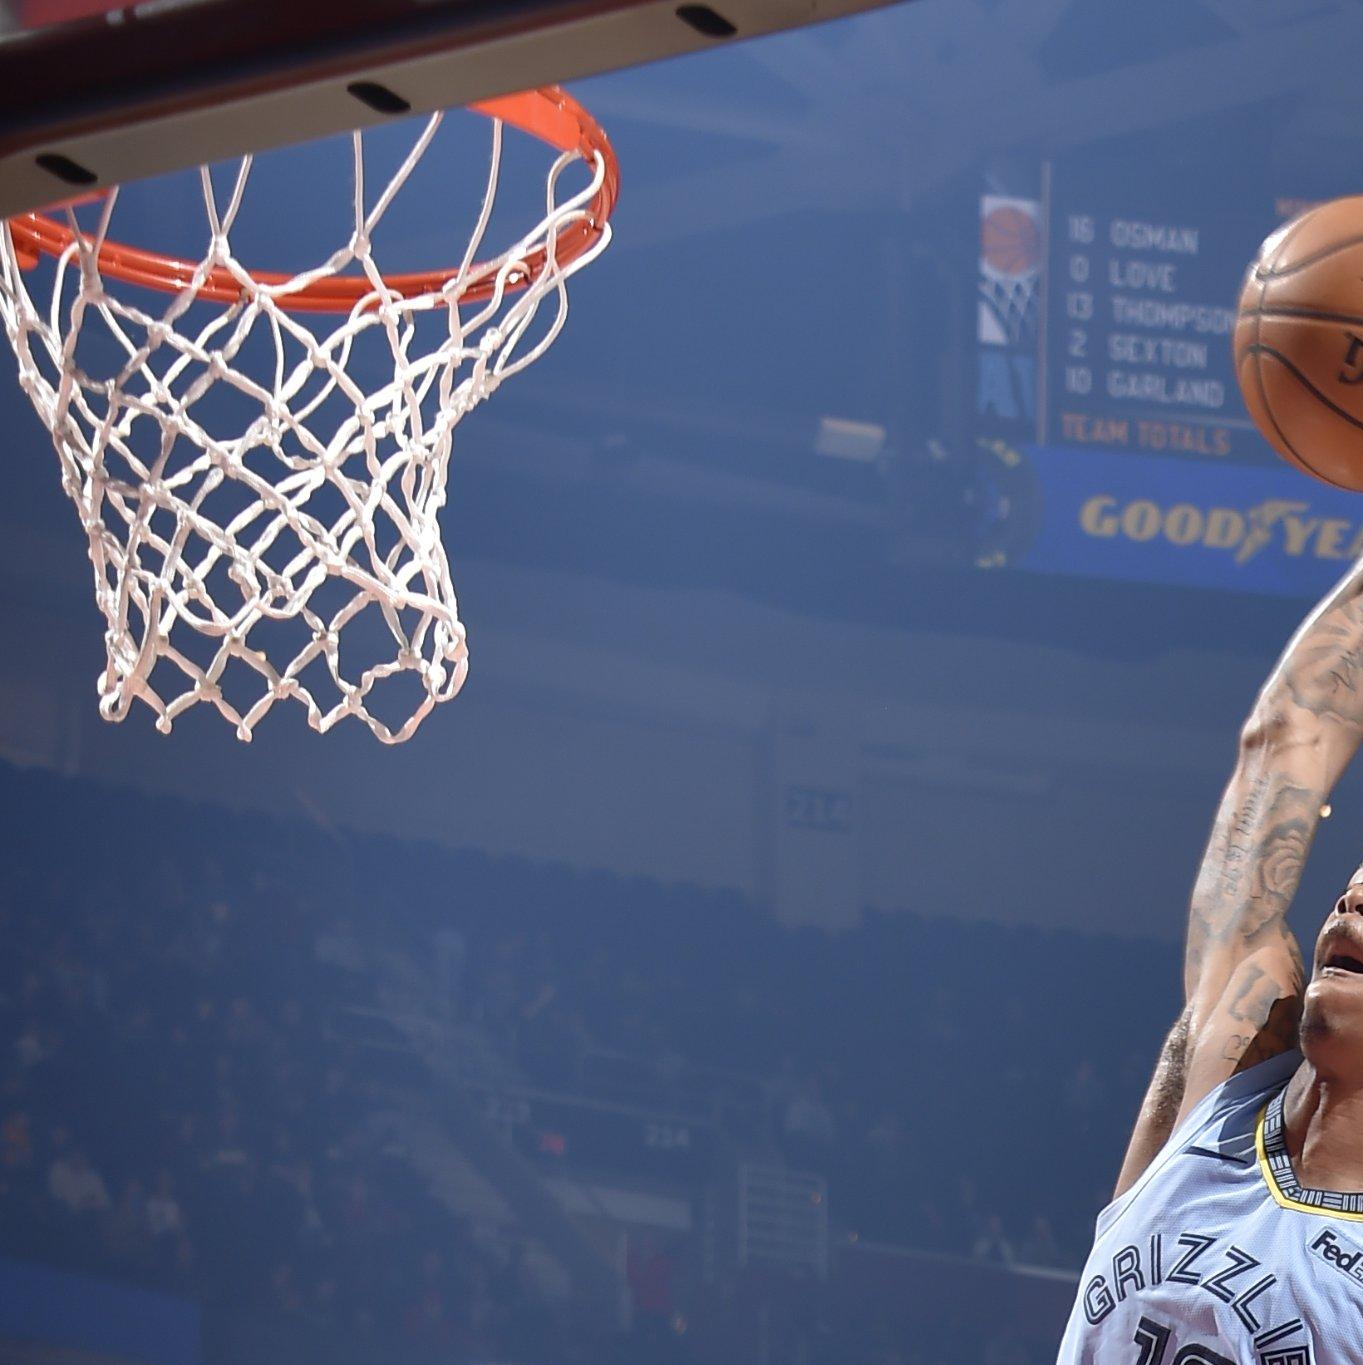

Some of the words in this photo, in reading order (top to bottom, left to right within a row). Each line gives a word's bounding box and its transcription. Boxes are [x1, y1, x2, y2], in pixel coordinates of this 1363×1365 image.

[1068, 214, 1095, 243] 16
[1110, 218, 1199, 254] OSMAN
[1070, 254, 1091, 283] 0
[1108, 257, 1177, 292] LOVE
[1066, 292, 1094, 321] 13
[1068, 329, 1088, 358] 2
[1107, 334, 1208, 370] SEXTON
[1065, 366, 1093, 394] 10
[1106, 369, 1225, 408] GARLAND
[1062, 412, 1129, 444] TEAM
[1137, 420, 1232, 456] TOTALS
